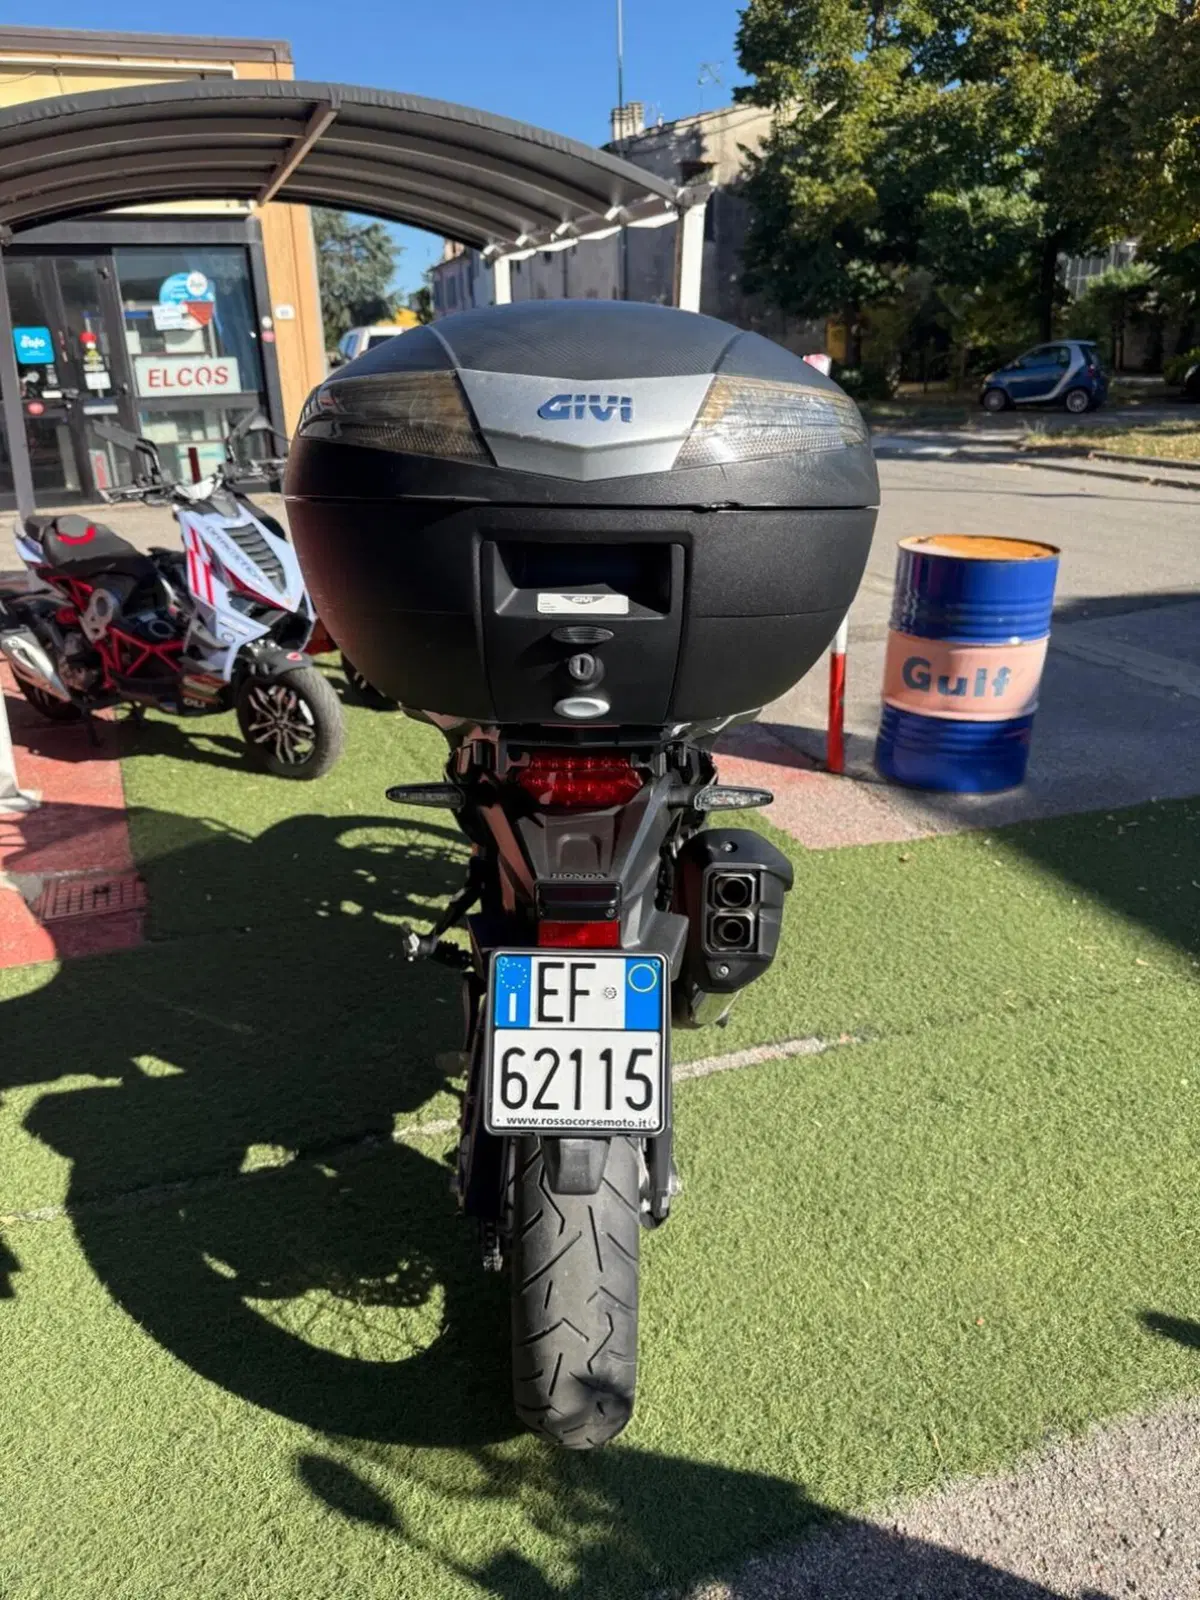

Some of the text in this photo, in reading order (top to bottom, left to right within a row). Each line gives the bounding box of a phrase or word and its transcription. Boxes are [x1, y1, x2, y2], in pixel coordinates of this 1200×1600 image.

[148, 366, 229, 388] ELCOS
[537, 394, 633, 423] GIVI
[902, 656, 1012, 697] Gulf
[550, 871, 607, 881] HONDA
[537, 961, 597, 1023] EF
[501, 1046, 653, 1112] 62115
[506, 1116, 647, 1128] www.rossocorsemoto.it
